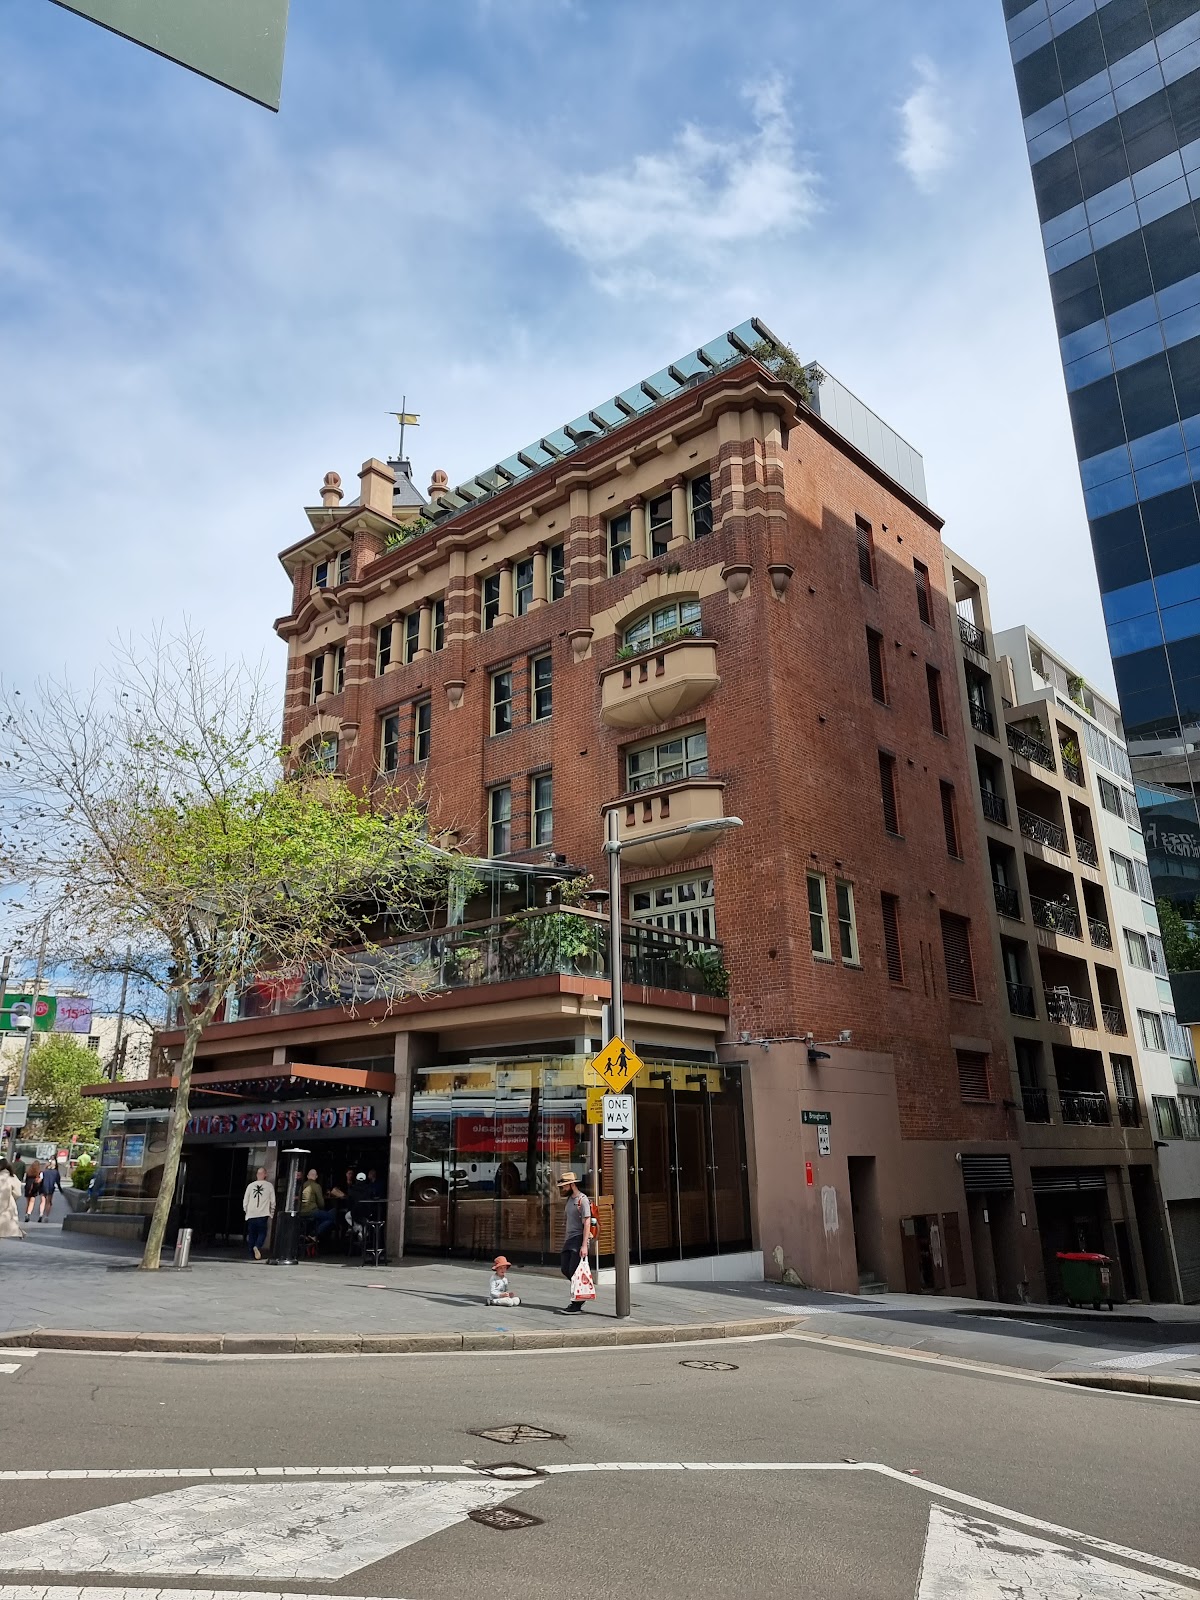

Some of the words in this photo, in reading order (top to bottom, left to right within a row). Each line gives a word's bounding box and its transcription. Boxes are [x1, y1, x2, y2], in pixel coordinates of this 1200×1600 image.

[608, 1099, 628, 1109] ONE
[238, 1109, 303, 1132] CROSS
[306, 1105, 377, 1129] HOTEL
[606, 1112, 630, 1123] WAY
[819, 1127, 828, 1135] ONE
[819, 1136, 829, 1144] WAY
